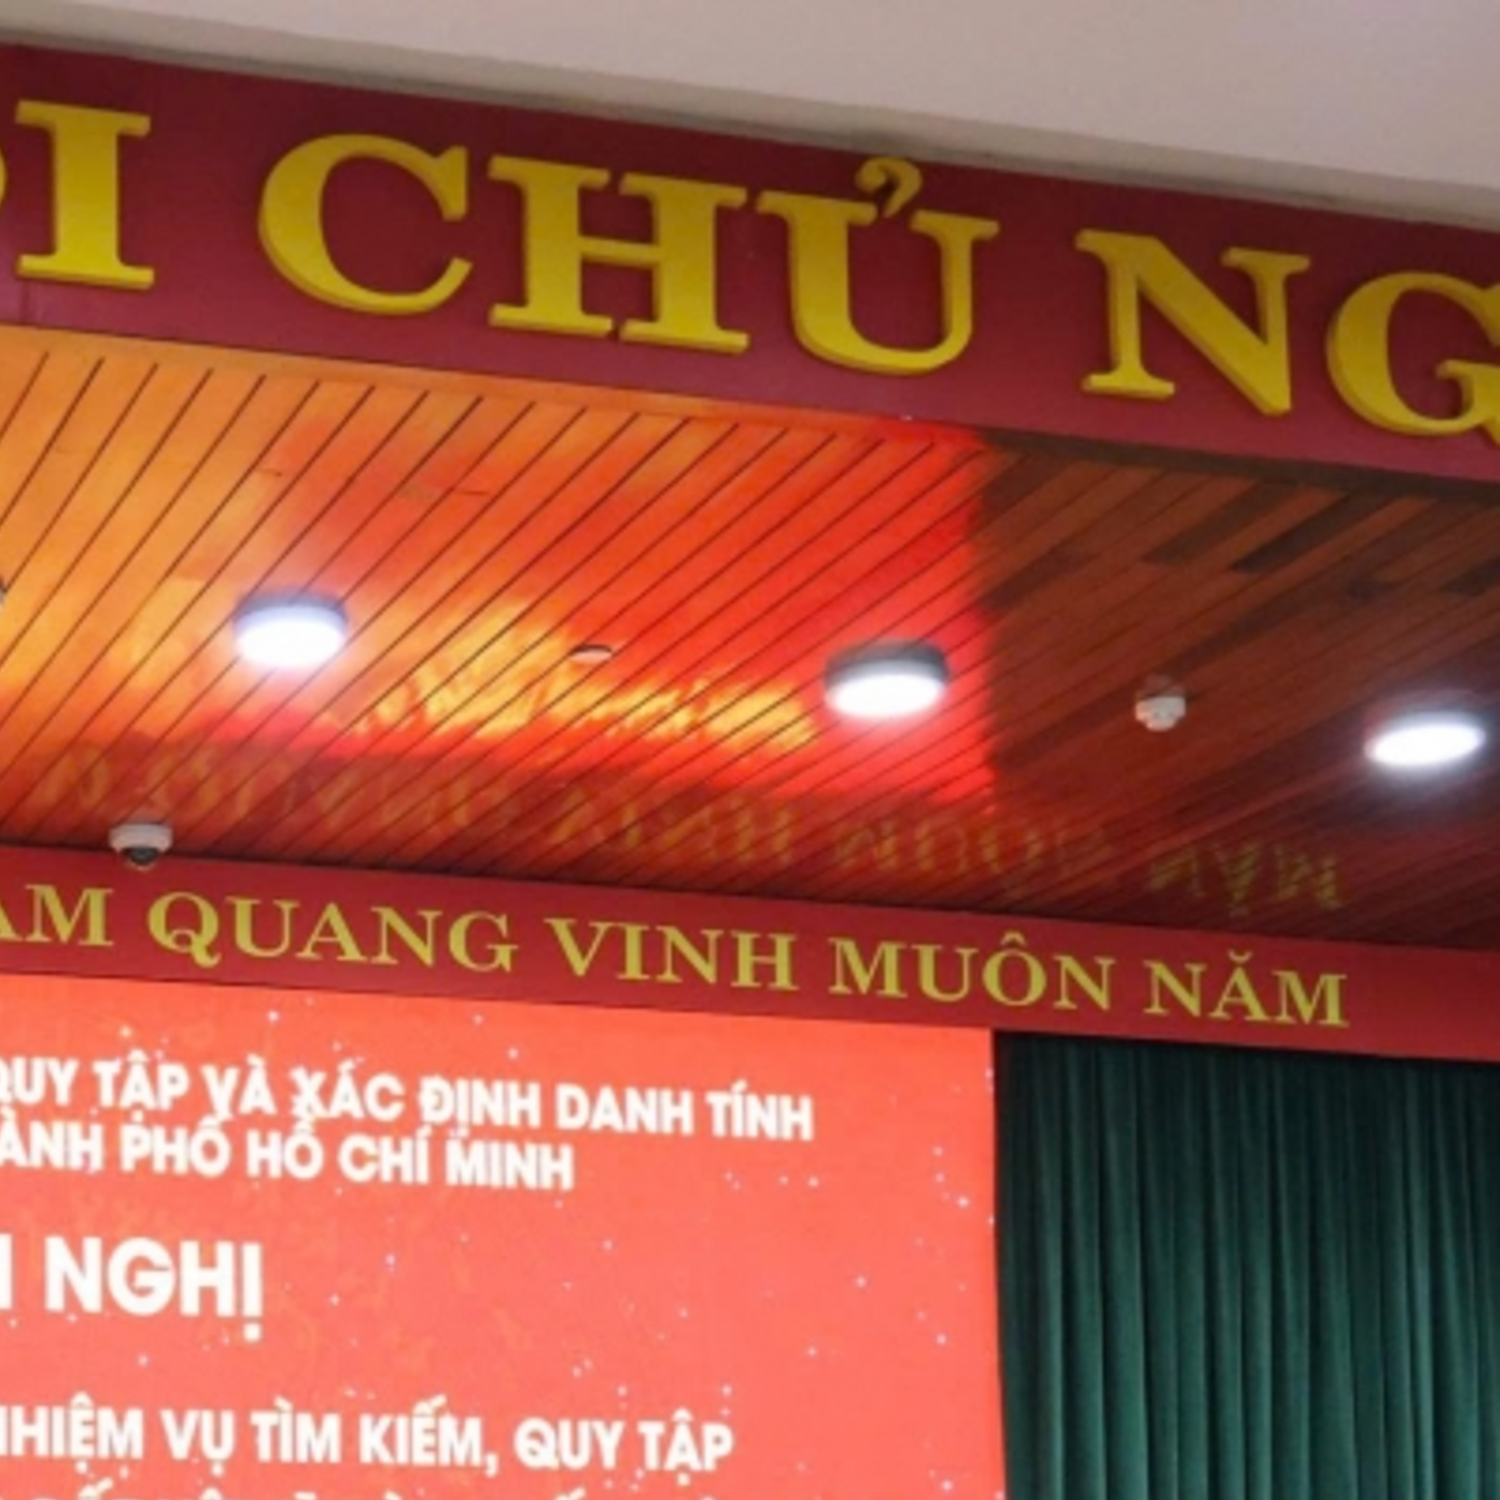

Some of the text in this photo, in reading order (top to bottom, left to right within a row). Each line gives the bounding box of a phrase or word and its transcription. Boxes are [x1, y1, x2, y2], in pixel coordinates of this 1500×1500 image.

[257, 130, 999, 376] CHỦ
[145, 888, 518, 972] QUANG
[545, 916, 800, 993] VINH
[830, 931, 1114, 1012] MUÔN
[1143, 949, 1350, 1028] NĂM
[92, 1048, 190, 1124] TẬP
[201, 1054, 277, 1116] VÀ
[290, 1059, 405, 1122] XÁC
[415, 1075, 542, 1137] ĐỊNH
[555, 1083, 694, 1136] DANH
[705, 1079, 814, 1141] TÍNH
[120, 1108, 233, 1178] PHỐ
[245, 1112, 326, 1180] HỒ
[337, 1119, 432, 1184] CHÍ
[445, 1139, 575, 1191] MINH
[43, 1235, 263, 1341] NGHỊ
[159, 1408, 237, 1477] VỤ
[250, 1396, 343, 1464] TÌM
[357, 1393, 499, 1477] KIẾM,
[512, 1417, 626, 1471] QUY
[637, 1408, 735, 1487] TẬP
